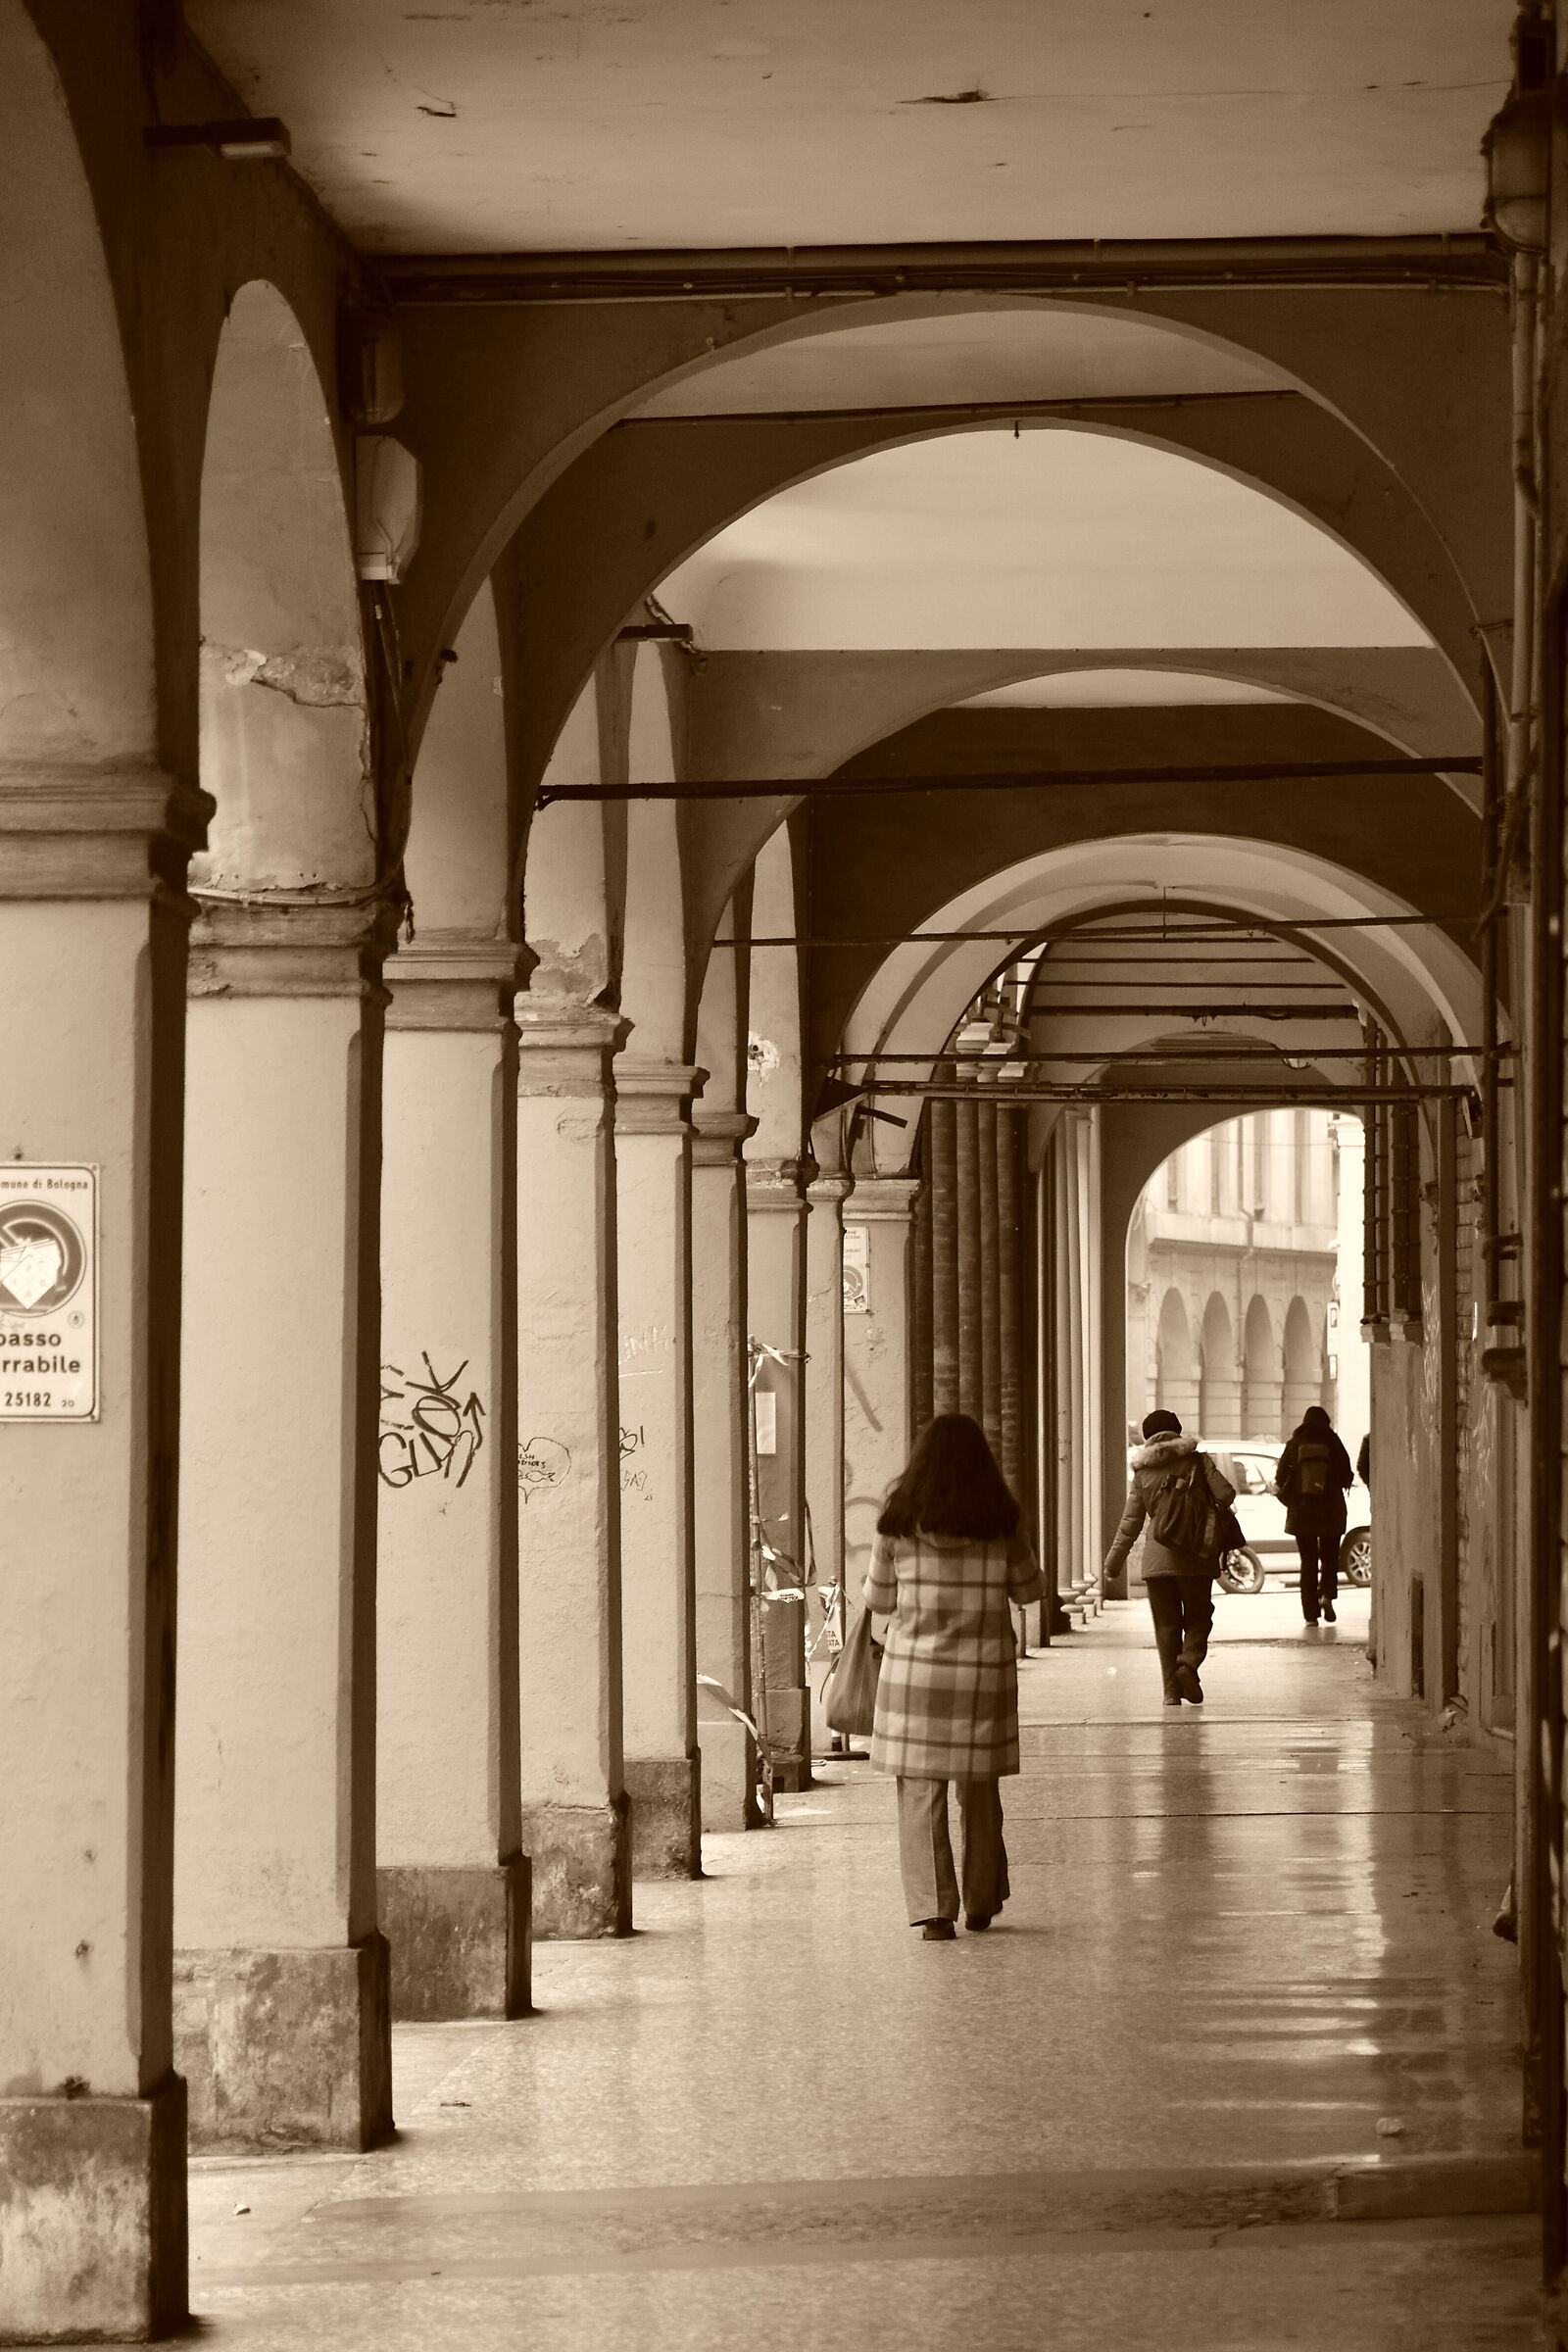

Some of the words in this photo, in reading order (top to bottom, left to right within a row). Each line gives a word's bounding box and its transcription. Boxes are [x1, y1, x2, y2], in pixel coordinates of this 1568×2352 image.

[32, 1178, 42, 1190] di
[47, 1178, 88, 1192] Bologna
[2, 1355, 80, 1373] rrabile
[5, 1392, 51, 1407] 25182
